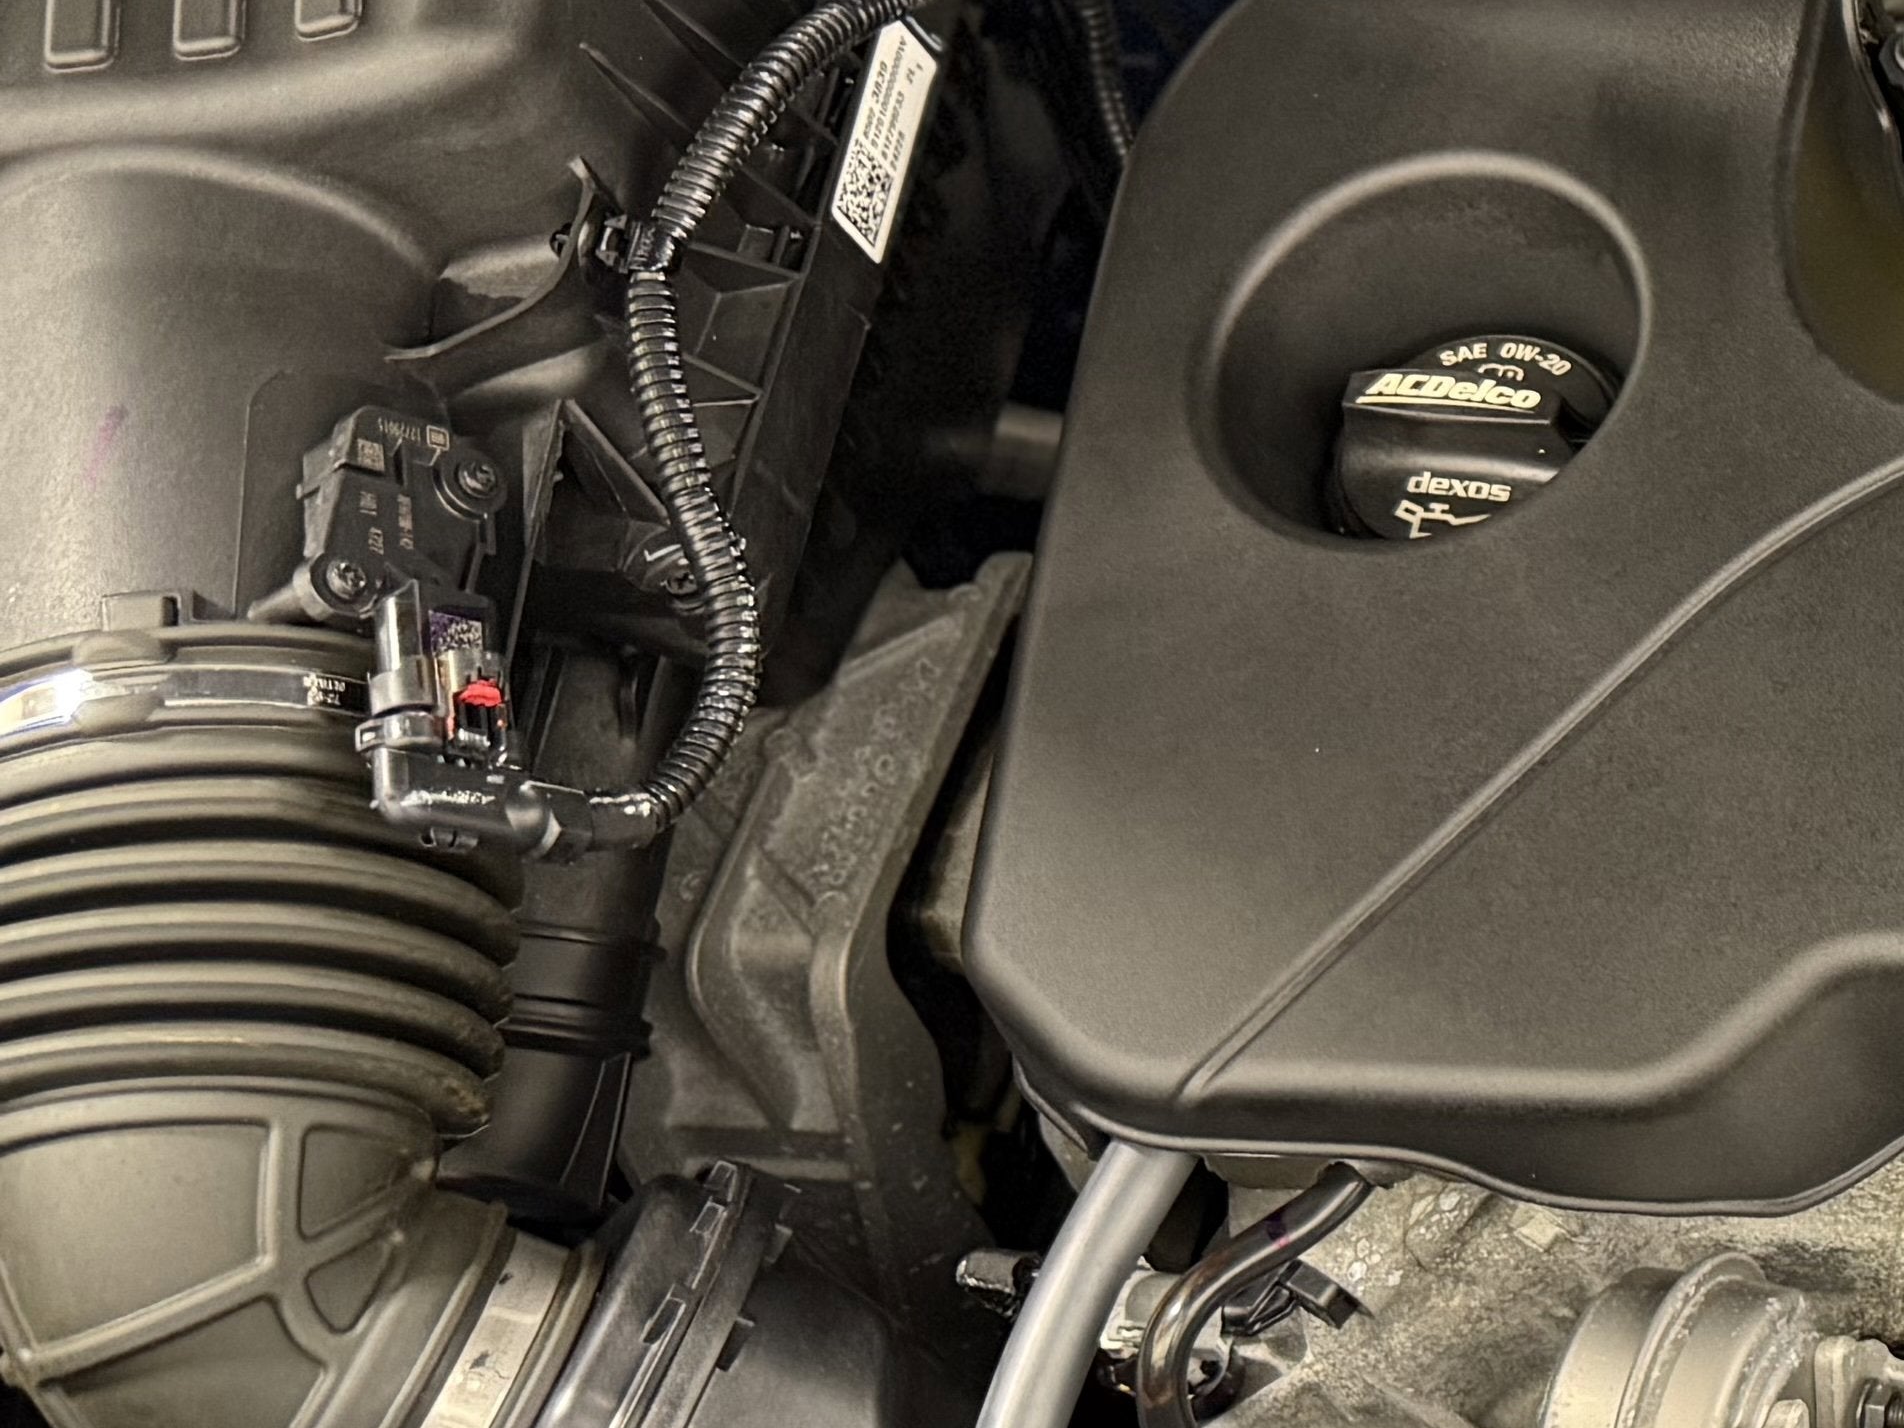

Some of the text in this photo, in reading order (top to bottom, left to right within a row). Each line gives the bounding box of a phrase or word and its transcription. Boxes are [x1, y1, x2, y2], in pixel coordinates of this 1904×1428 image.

[1439, 342, 1572, 377] SAE 0W-20
[1364, 373, 1542, 409] ACDelco
[1406, 471, 1513, 503] dexos
